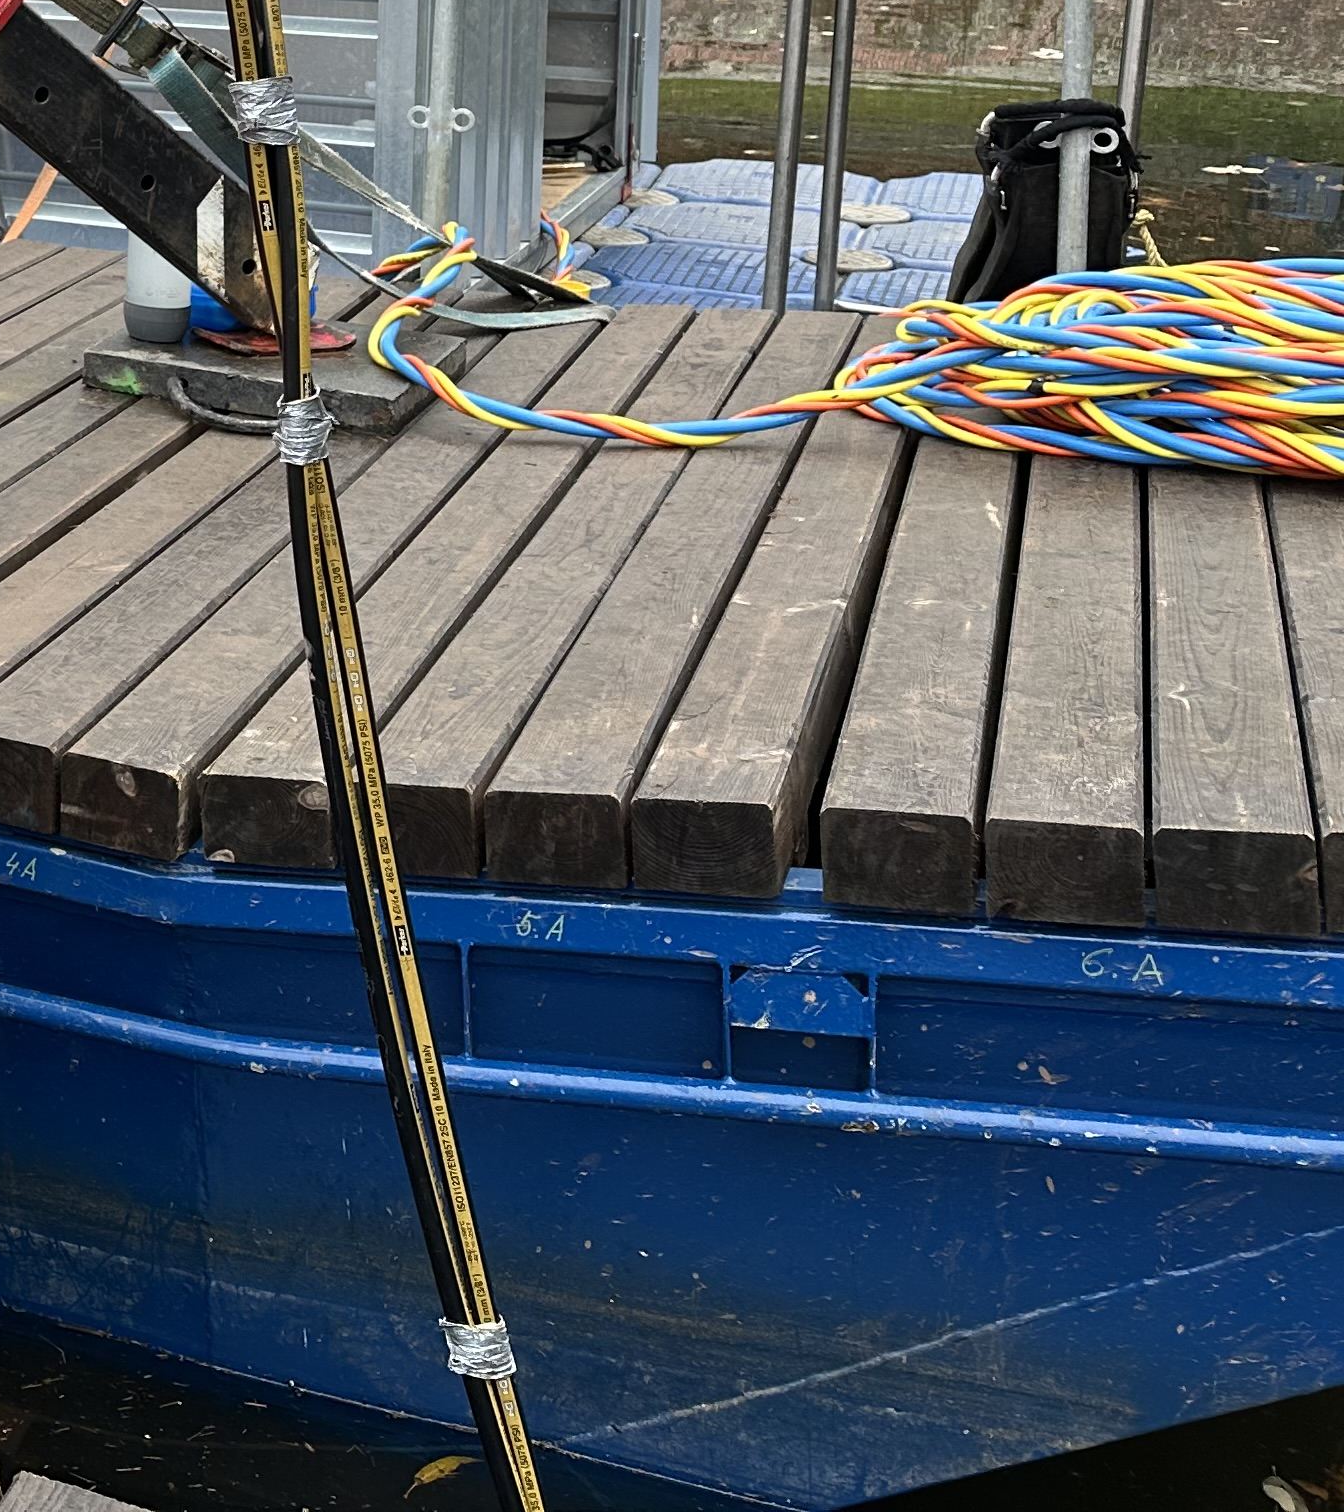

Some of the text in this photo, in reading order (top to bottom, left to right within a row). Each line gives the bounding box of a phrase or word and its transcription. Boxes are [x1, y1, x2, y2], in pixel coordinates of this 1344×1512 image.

[236, 11, 249, 37] (5075
[242, 40, 252, 60] MPa
[339, 605, 348, 616] 10
[357, 719, 369, 739] PSI)
[362, 740, 374, 766] (5075
[368, 768, 378, 788] MPa
[374, 812, 384, 828] WP
[384, 858, 395, 883] 462-6
[422, 1044, 433, 1066] Italy
[426, 1066, 435, 1076] in
[429, 1077, 441, 1101] Made
[435, 1105, 444, 1117] 10
[438, 1119, 449, 1138] 2SC
[442, 1140, 466, 1213] ISO11237/EN857
[523, 1470, 535, 1491] MPa
